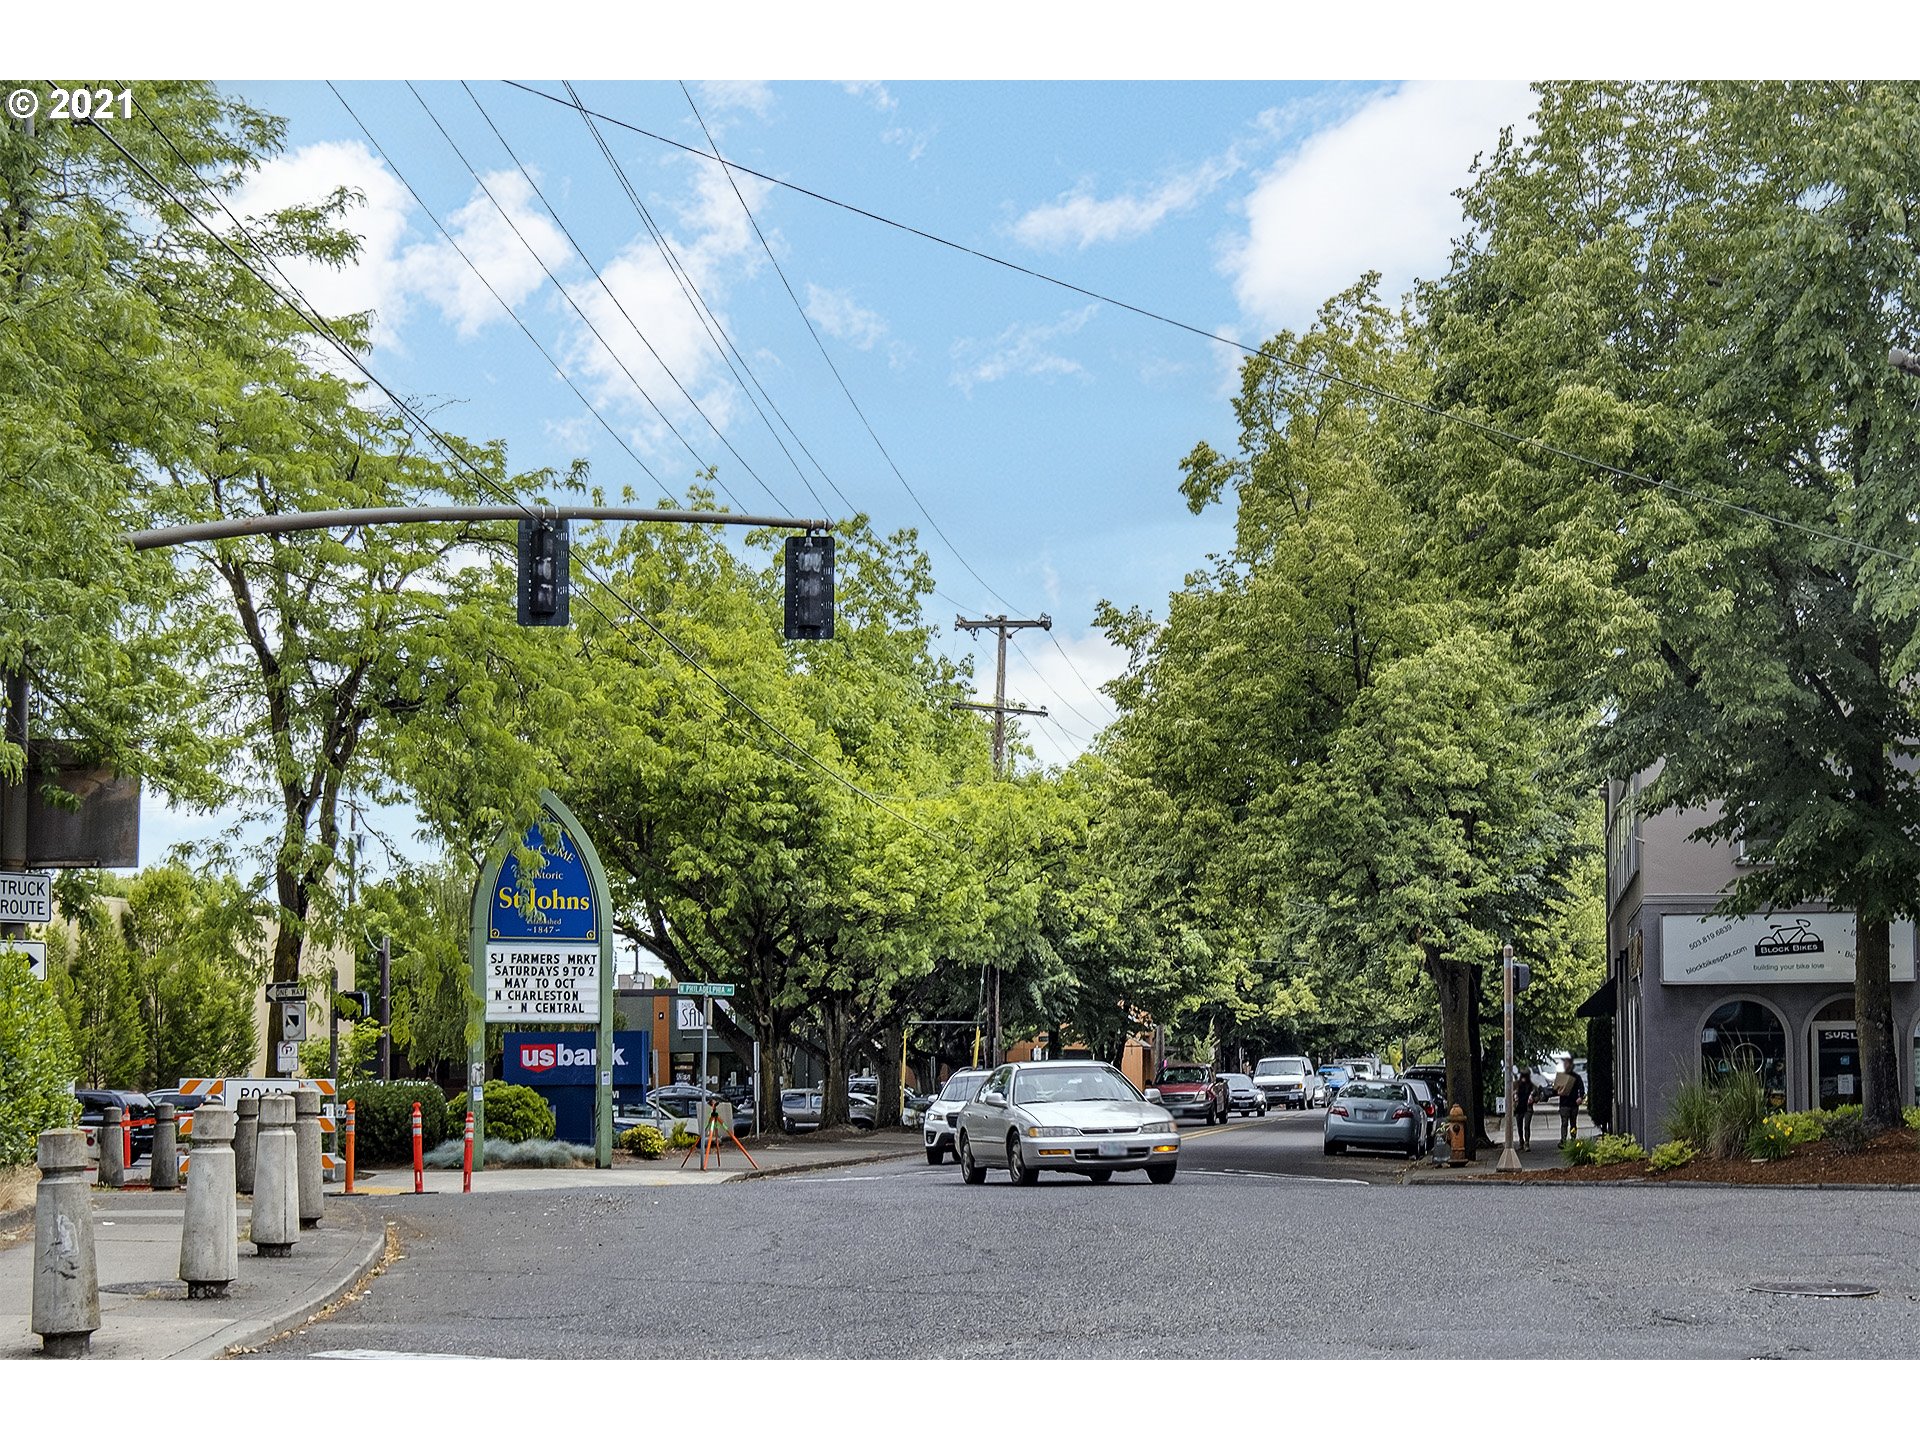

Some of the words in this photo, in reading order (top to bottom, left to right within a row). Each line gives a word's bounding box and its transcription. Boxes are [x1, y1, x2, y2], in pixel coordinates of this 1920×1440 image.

[0, 880, 46, 896] TRUCK
[529, 888, 590, 912] Johns
[0, 900, 46, 915] ROUTE
[1760, 946, 1790, 954] BLOCK
[1792, 944, 1818, 952] BIKES
[490, 953, 504, 964] SJ
[511, 953, 560, 965] FARMERS
[567, 954, 597, 965] MRKT
[1685, 945, 1748, 975] blockbikespdx.com
[495, 965, 559, 976] SATURDAYS
[562, 966, 569, 976] 9
[572, 966, 585, 977] TO
[588, 966, 594, 977] 2
[1753, 963, 1779, 972] building
[1780, 964, 1795, 972] your
[504, 978, 528, 988] MAY
[536, 978, 549, 988] TO
[555, 978, 576, 989] OCT
[276, 988, 288, 997] ONE
[291, 988, 304, 996] WAY
[686, 985, 725, 994] PHILADELPHIA
[495, 990, 502, 1000] N
[507, 990, 579, 1001] CHARLESTON
[521, 1003, 527, 1013] N
[535, 1003, 585, 1013] CENTRAL
[681, 1007, 703, 1027] SAL
[1825, 1031, 1857, 1040] SURL
